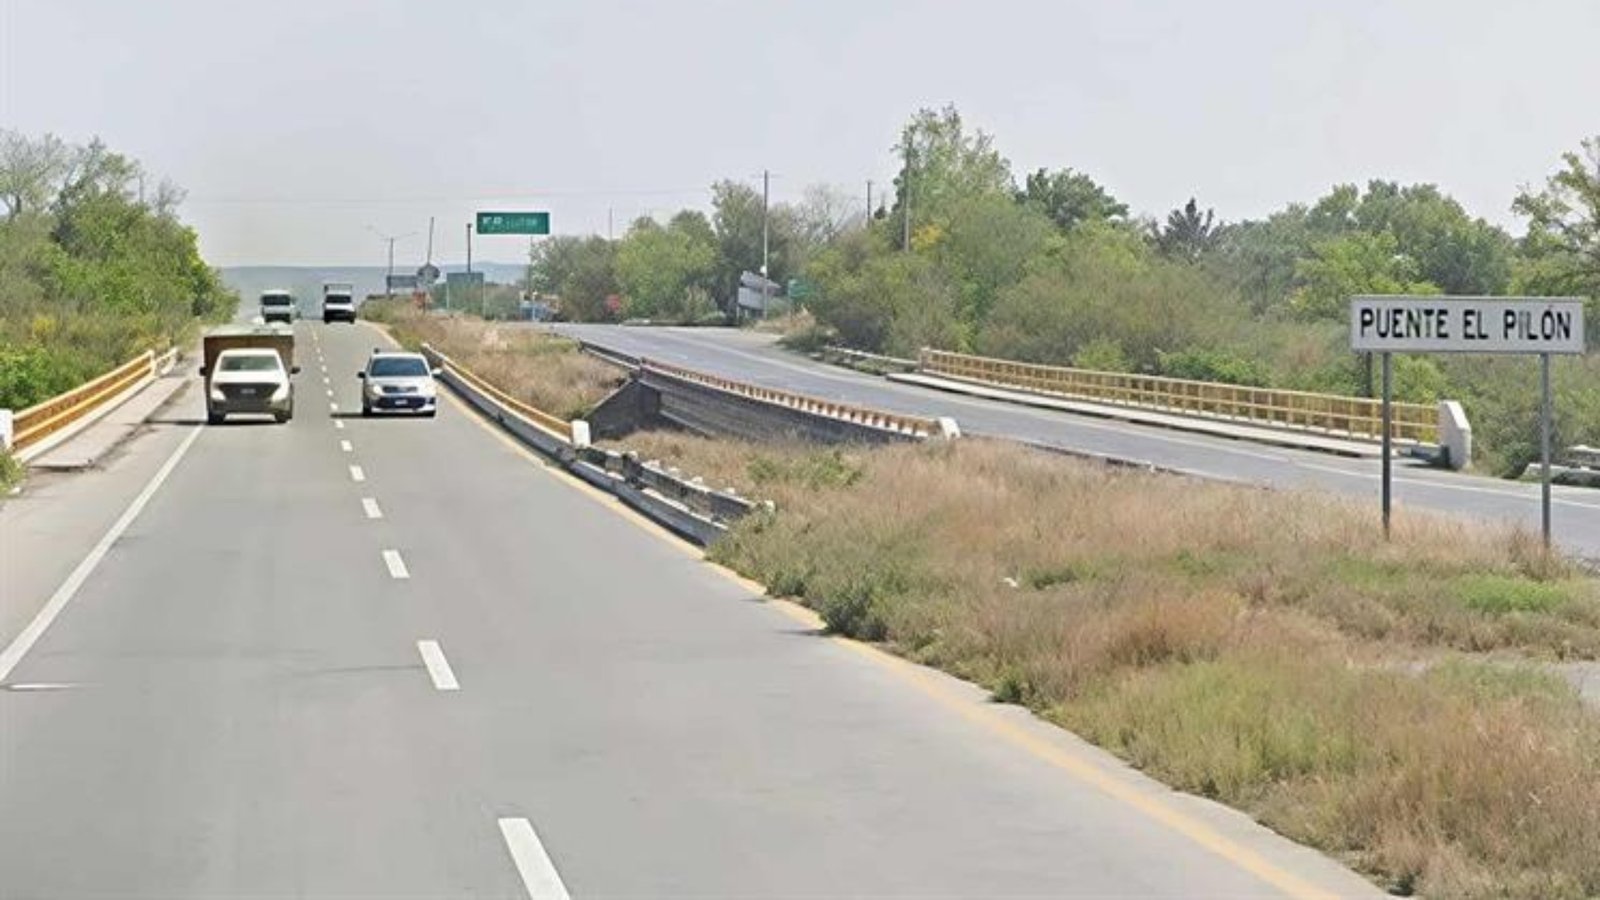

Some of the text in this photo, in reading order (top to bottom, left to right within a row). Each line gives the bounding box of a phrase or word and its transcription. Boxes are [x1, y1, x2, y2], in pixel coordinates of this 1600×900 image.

[1360, 305, 1571, 340] PUENTE EL PILÓN
